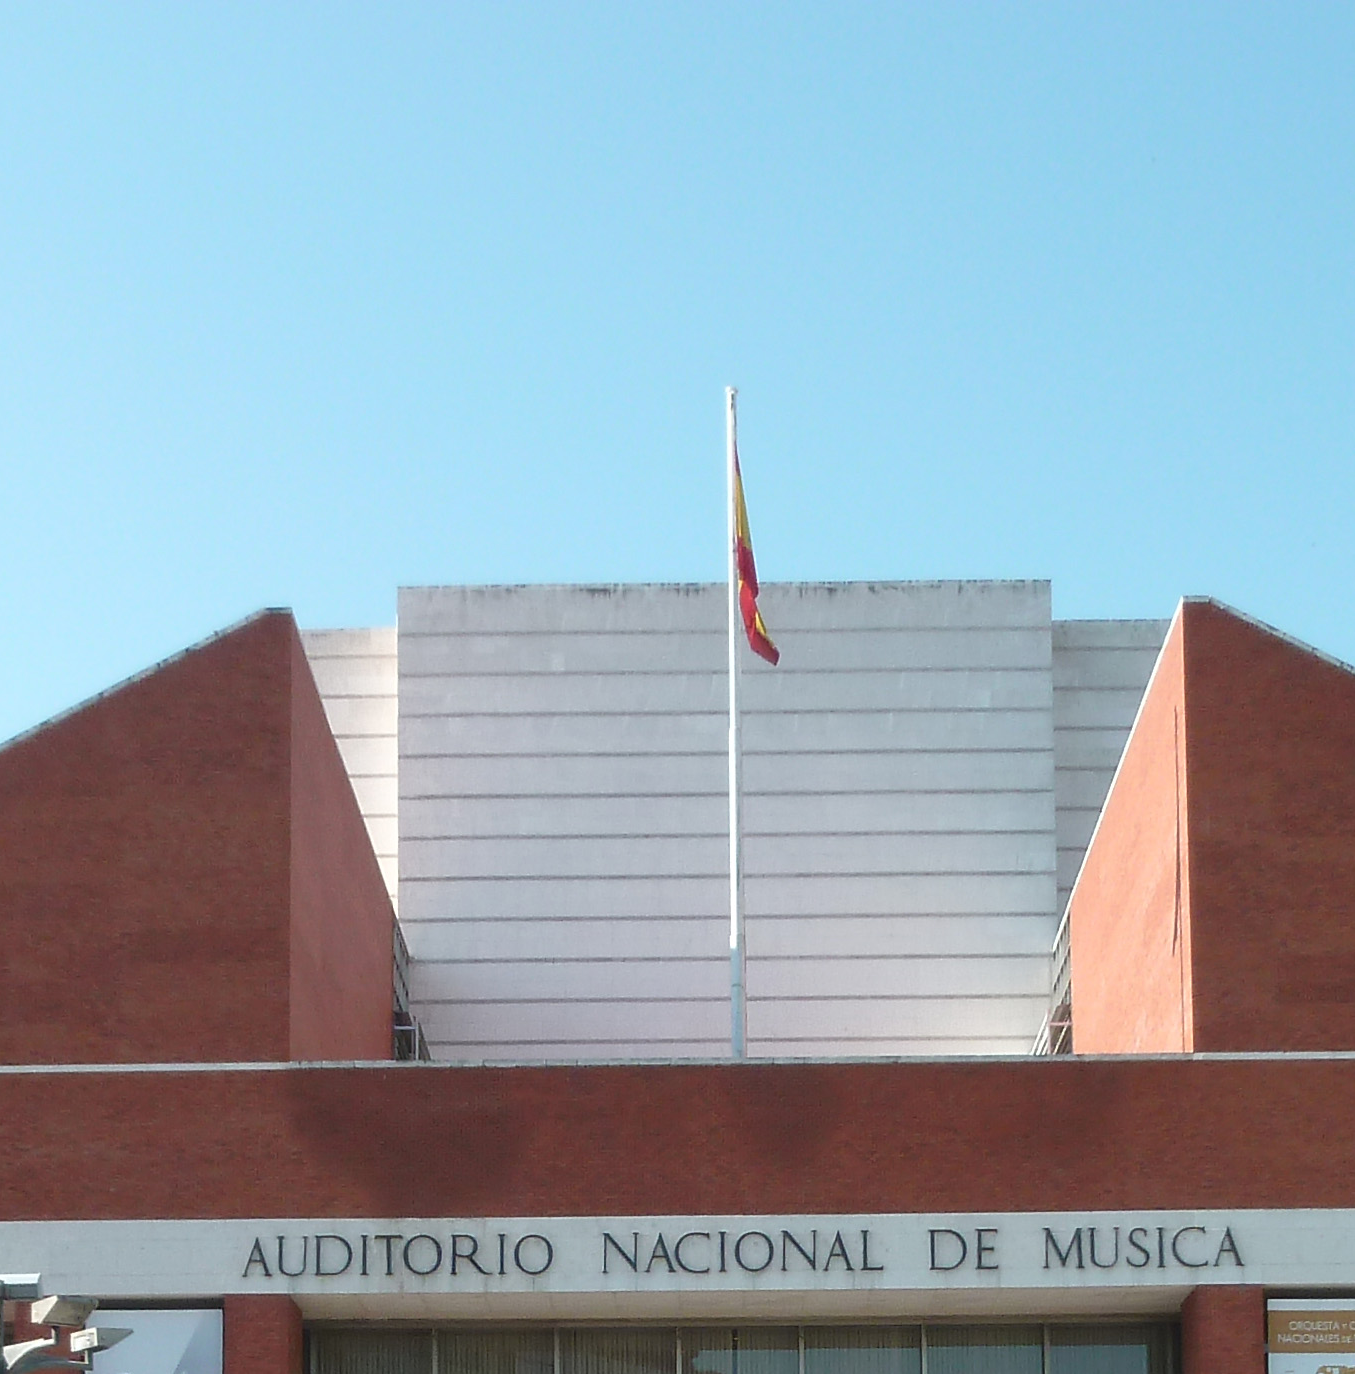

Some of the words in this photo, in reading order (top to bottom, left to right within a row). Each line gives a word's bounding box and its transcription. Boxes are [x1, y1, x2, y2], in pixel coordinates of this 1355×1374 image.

[242, 1233, 554, 1278] AUDITORIO
[602, 1229, 885, 1275] NACIONAL
[928, 1228, 1000, 1272] DE
[1042, 1225, 1245, 1270] MUSICA
[1288, 1320, 1340, 1331] ORQUESTA
[1277, 1333, 1340, 1344] NACIONALES
